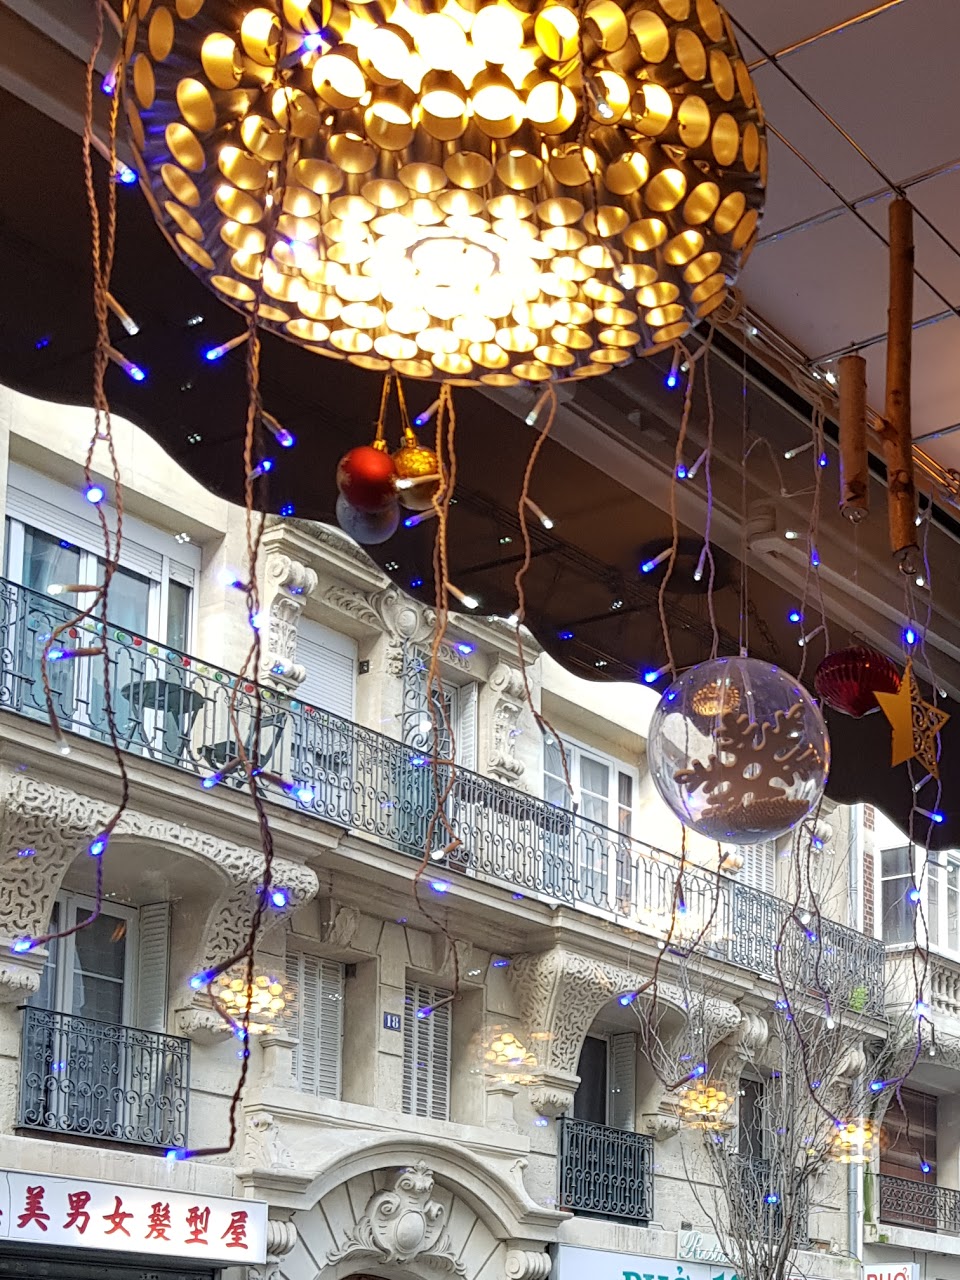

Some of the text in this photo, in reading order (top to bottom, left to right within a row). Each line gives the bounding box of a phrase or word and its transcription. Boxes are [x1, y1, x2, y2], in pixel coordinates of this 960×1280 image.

[386, 1014, 399, 1029] 18
[0, 1185, 249, 1250] 美男女髮型屋
